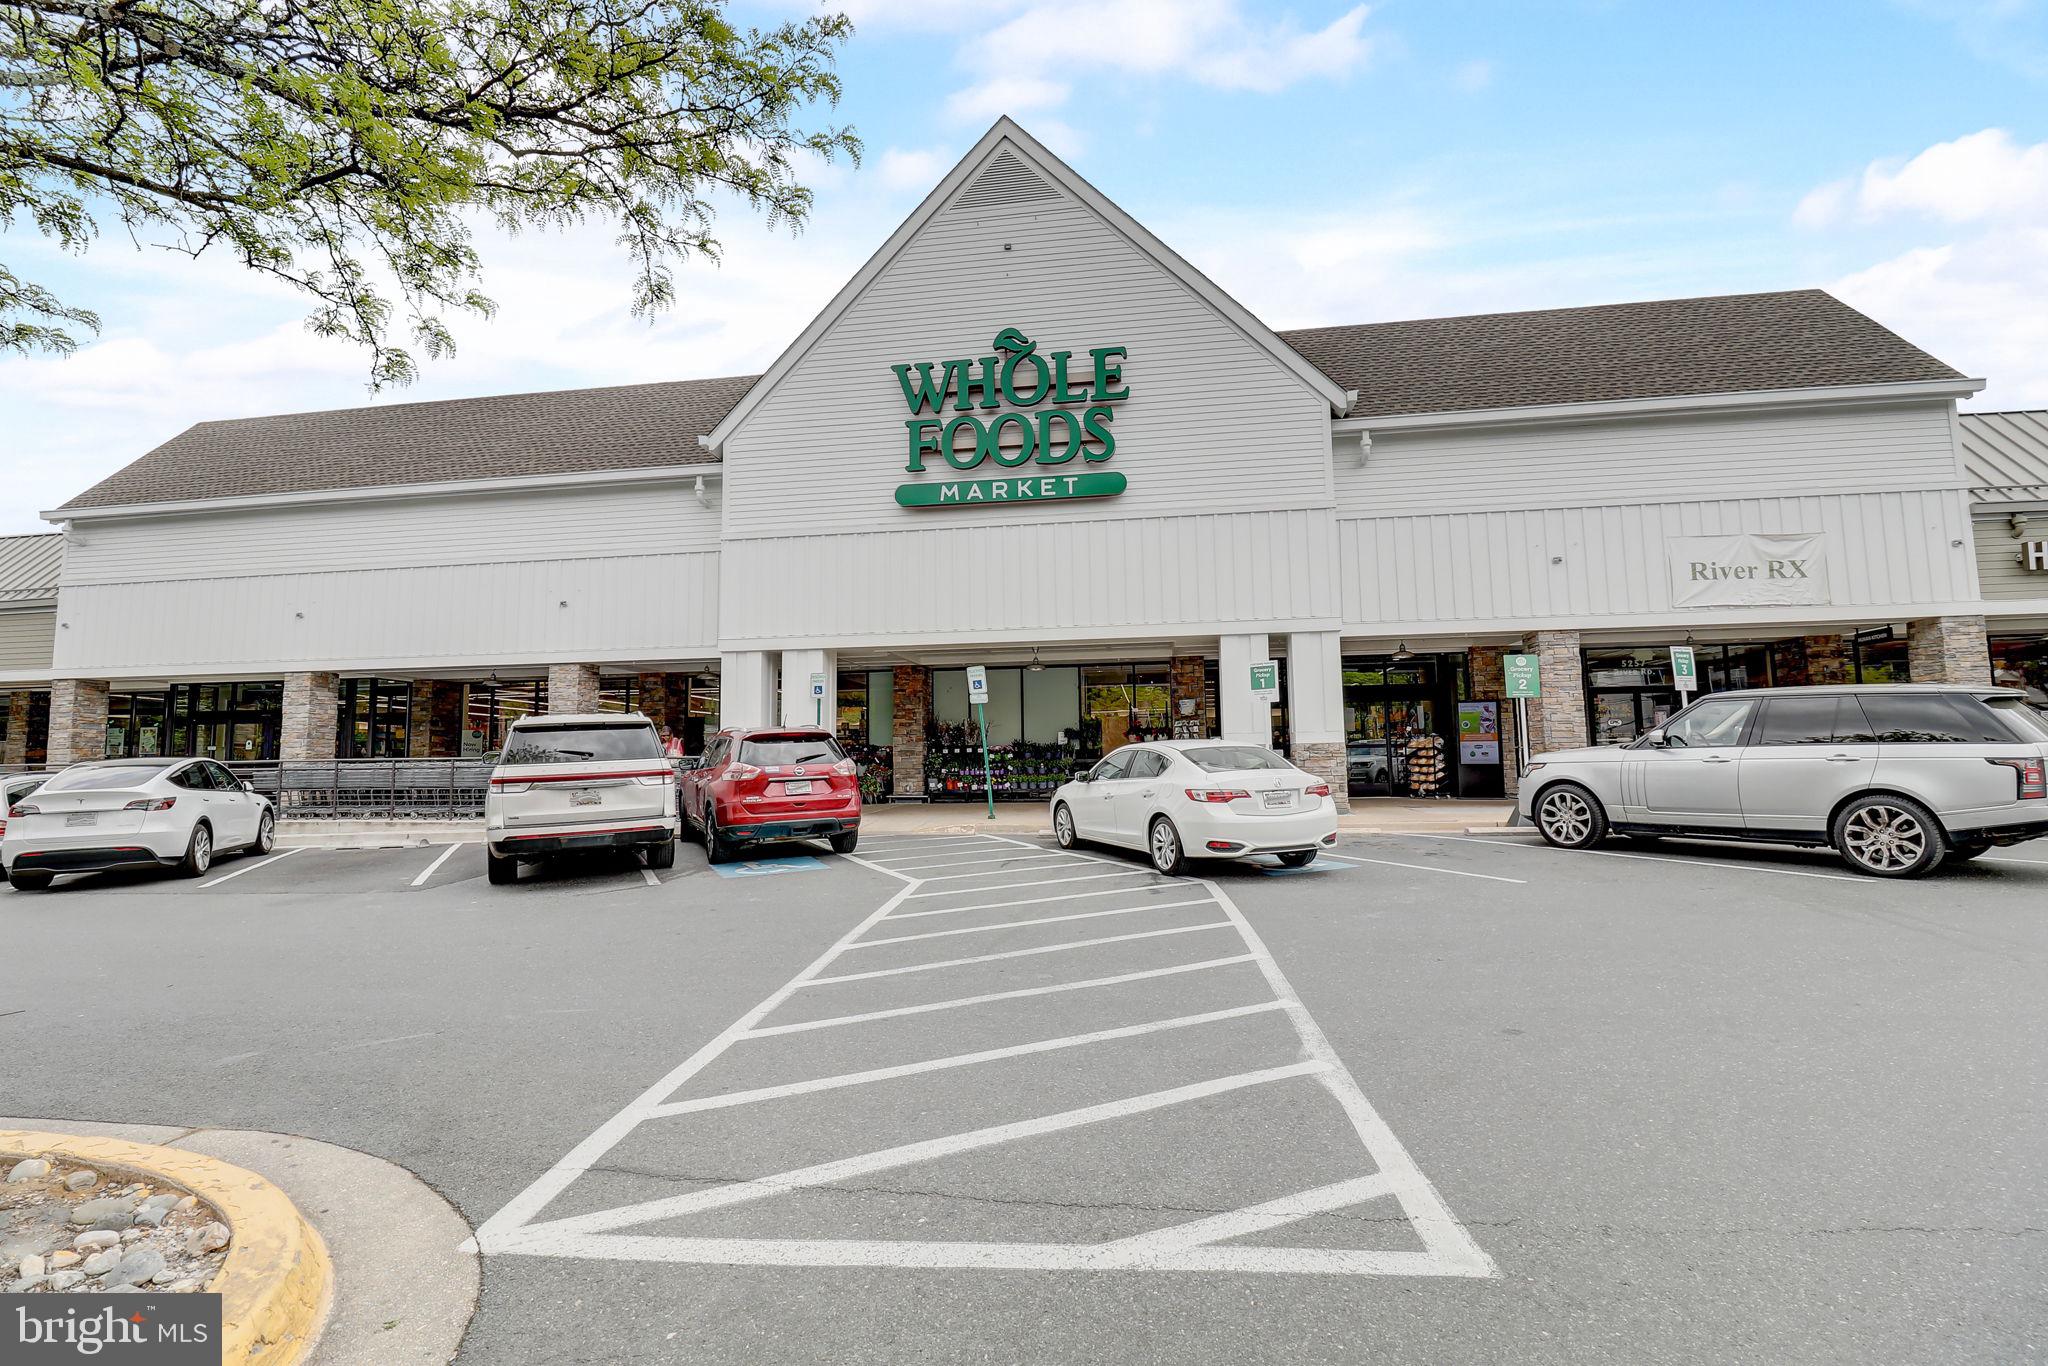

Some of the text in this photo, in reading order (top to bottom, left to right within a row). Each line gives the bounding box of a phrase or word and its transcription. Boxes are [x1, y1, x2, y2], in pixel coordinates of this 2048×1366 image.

[890, 336, 1131, 416] WHOLE
[904, 406, 1116, 473] FOODS
[940, 477, 1078, 501] MARKET
[1690, 559, 1808, 581] River RX
[1681, 664, 1687, 675] 3
[1260, 678, 1265, 688] 1
[1518, 679, 1527, 689] 2
